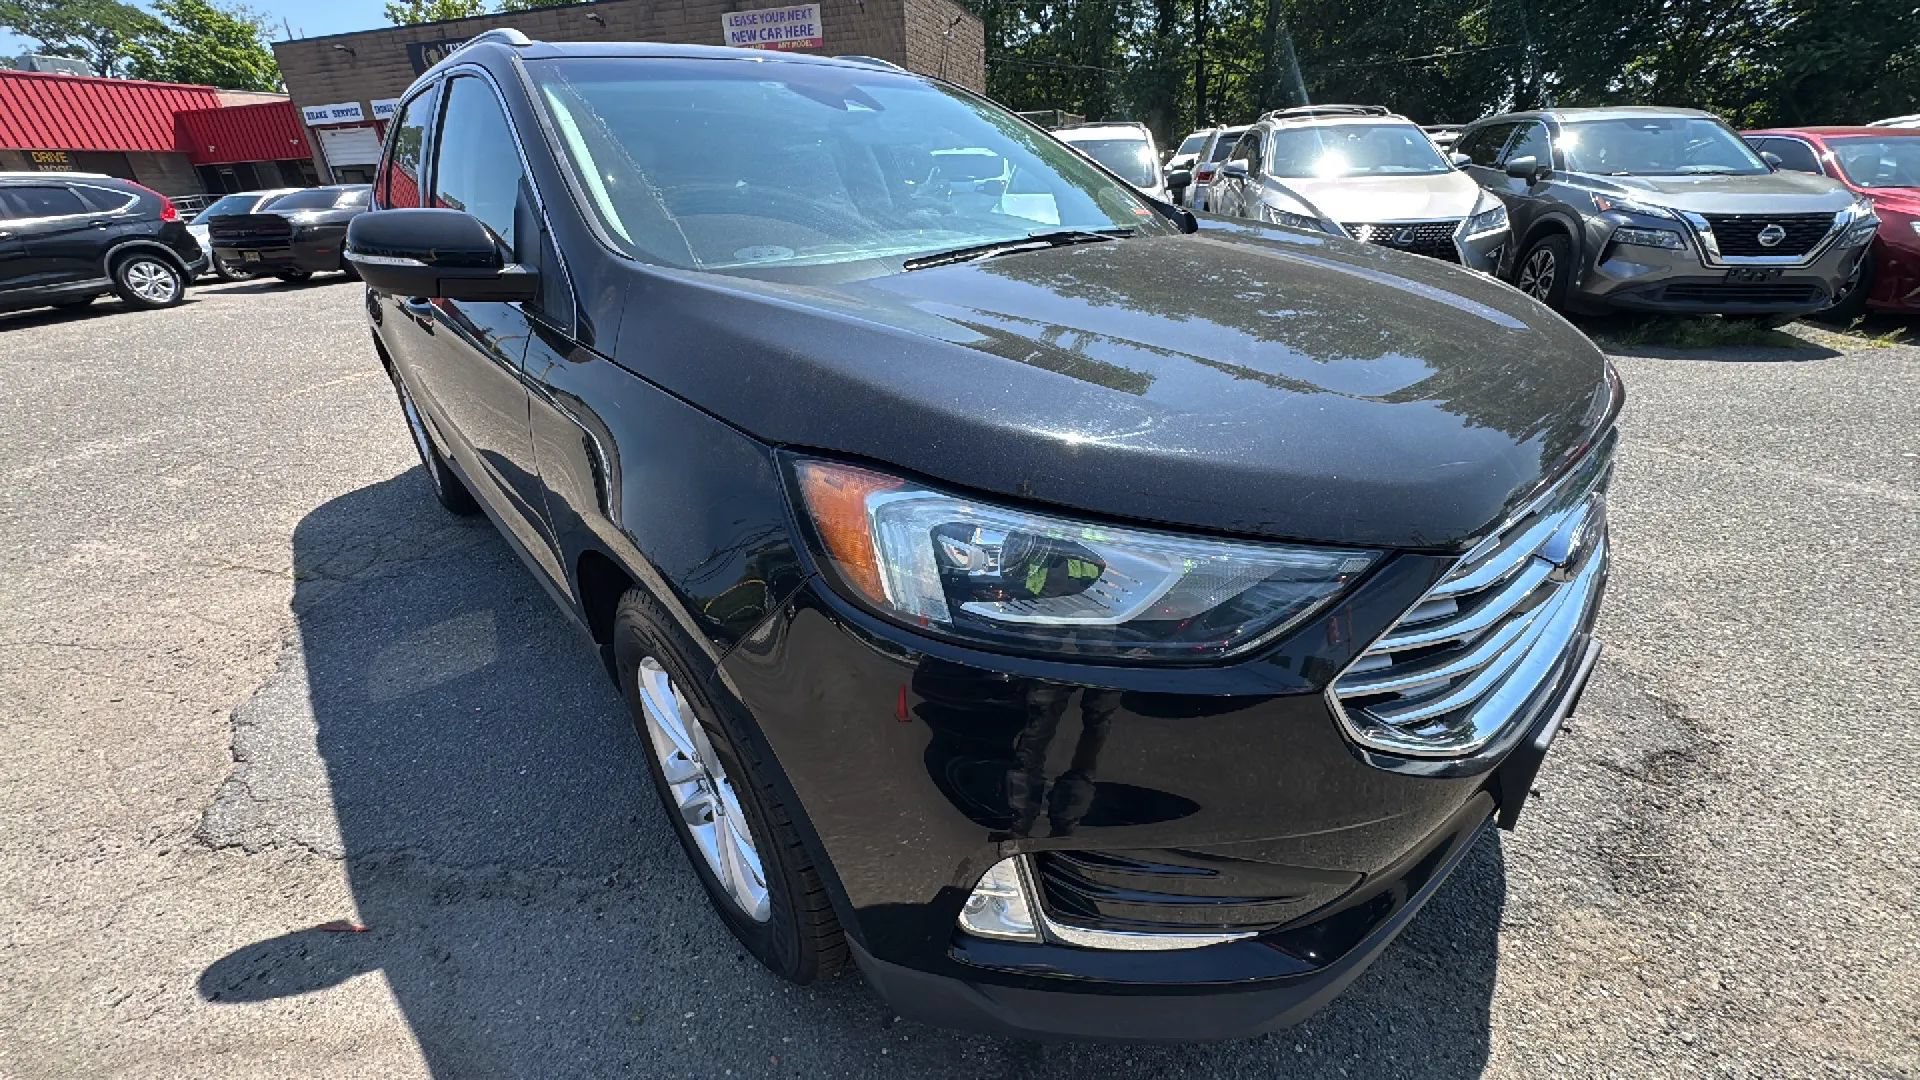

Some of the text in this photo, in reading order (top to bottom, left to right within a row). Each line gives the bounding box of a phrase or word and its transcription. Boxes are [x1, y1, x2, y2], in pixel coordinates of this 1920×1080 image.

[729, 8, 813, 27] LEASE YOUR NEXT
[732, 23, 815, 43] NEW CAR HERE
[306, 108, 360, 120] BRAKE SERVICE
[32, 152, 68, 162] DRIVE
